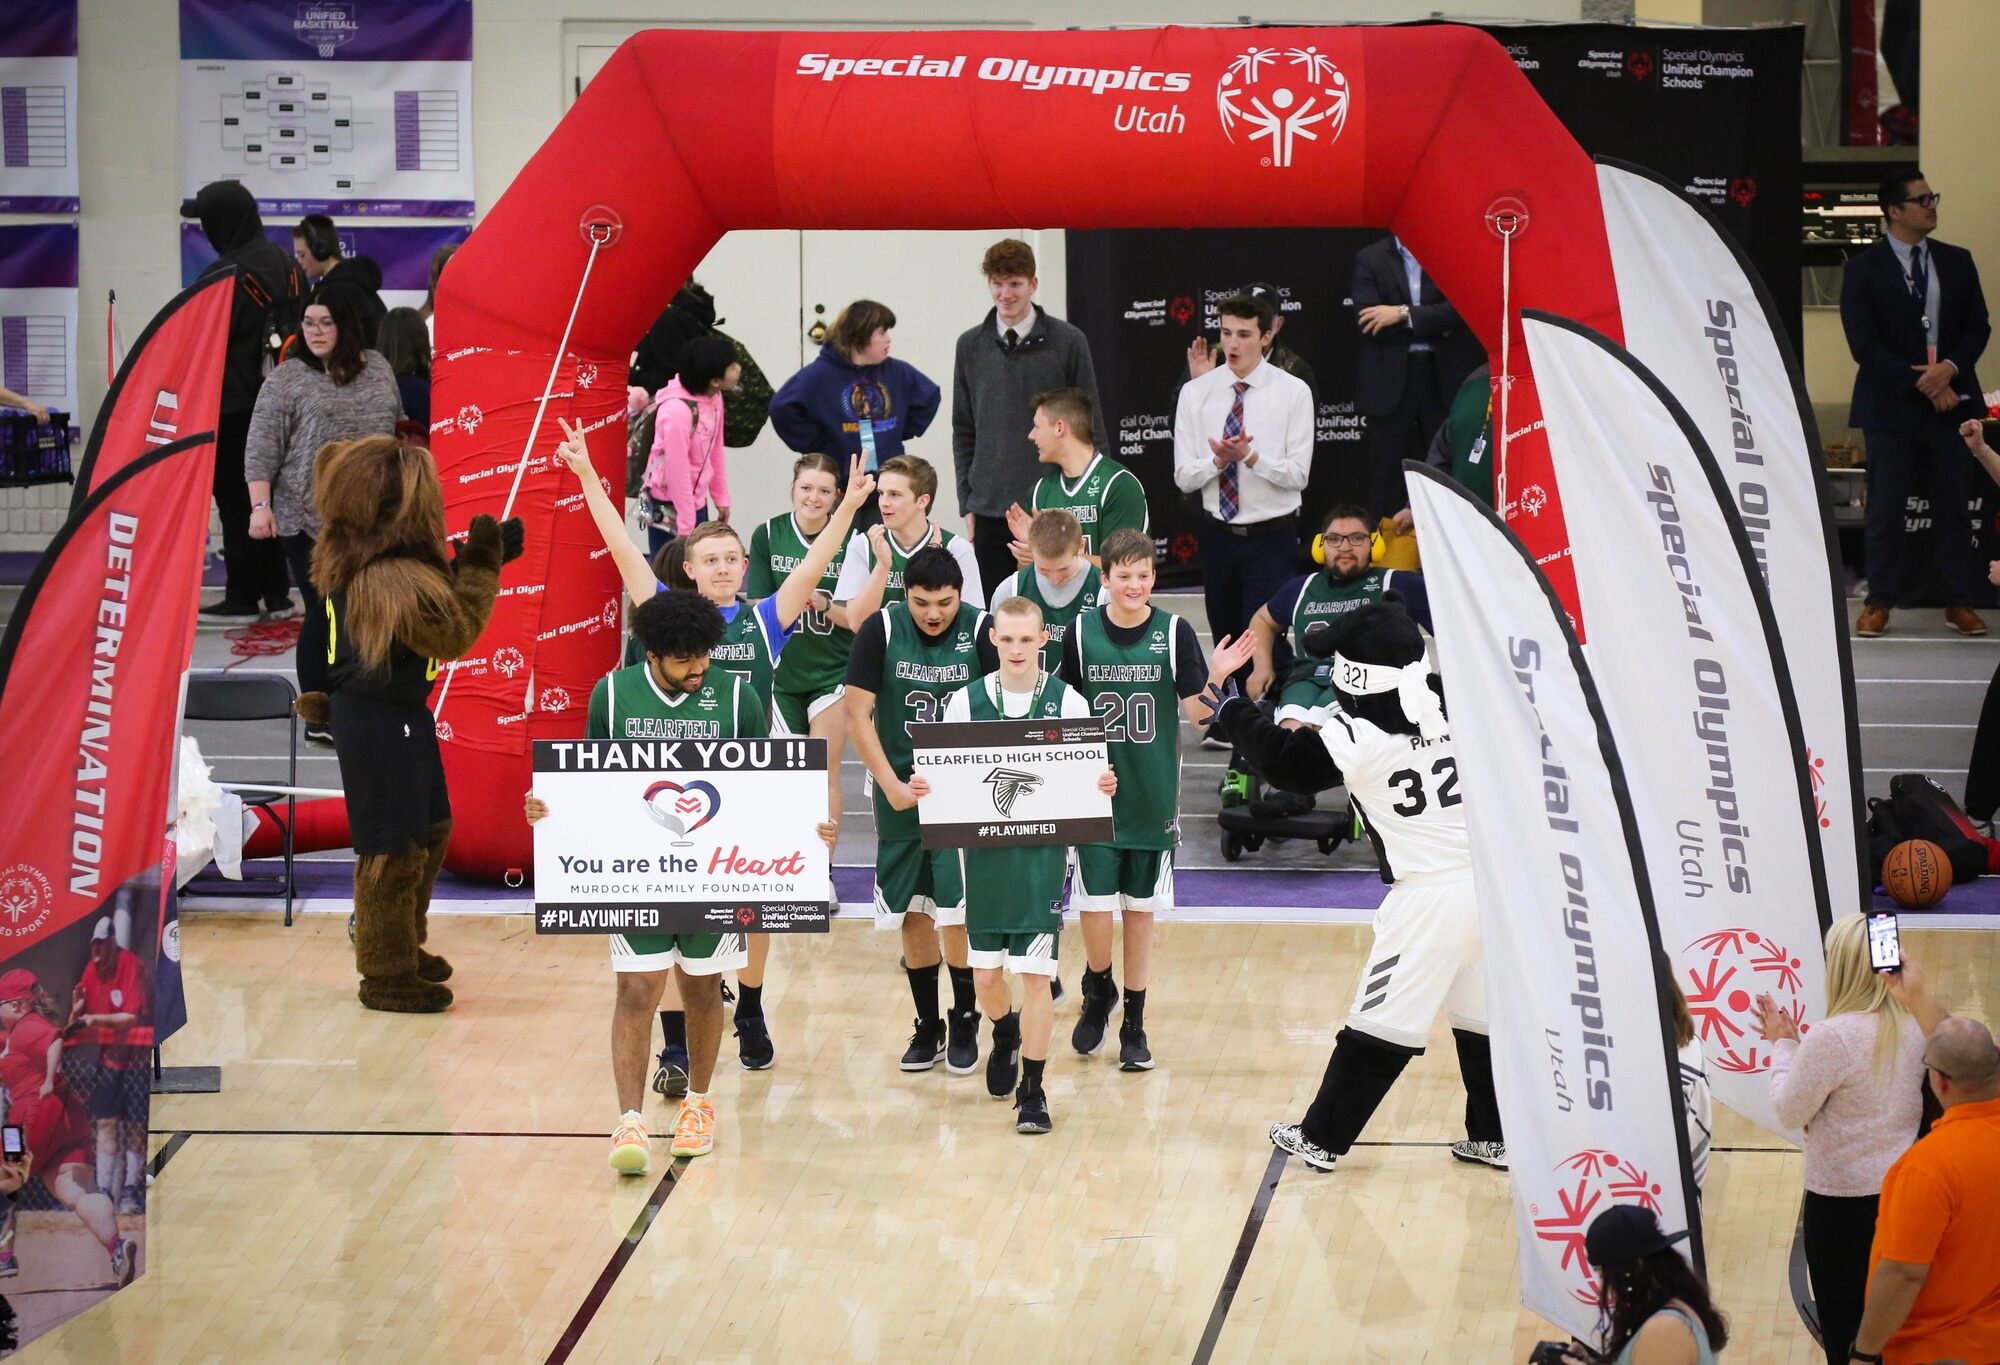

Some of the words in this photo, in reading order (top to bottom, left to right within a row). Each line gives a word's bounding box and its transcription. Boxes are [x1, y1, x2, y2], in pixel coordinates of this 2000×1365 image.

[306, 12, 346, 20] UNIFIED
[294, 20, 358, 29] BASKETBALL
[1588, 50, 1623, 60] Special
[1663, 49, 1697, 62] Special
[1700, 50, 1744, 63] Olympics
[1578, 59, 1623, 69] Olympics
[1663, 63, 1700, 76] Unified
[1703, 65, 1754, 79] Champion
[797, 53, 967, 79] Special
[977, 56, 1191, 94] Olympics
[1663, 77, 1703, 88] Schools
[1114, 104, 1185, 134] Utah
[1694, 177, 1727, 187] Special
[1685, 186, 1727, 196] Olympics
[1205, 289, 1240, 301] Special
[1133, 300, 1166, 310] Special
[1124, 310, 1166, 319] Olympics
[447, 347, 475, 361] Special
[1703, 299, 1764, 466] Special
[1317, 416, 1358, 428] Unified
[1317, 428, 1361, 440] Schools
[459, 468, 494, 484] Special
[530, 465, 548, 475] Utah
[568, 502, 585, 512] Utah
[559, 615, 600, 634] Olympics
[588, 624, 601, 635] Utah
[471, 666, 488, 675] Utah
[896, 661, 969, 681] CLEARFIELD
[1088, 664, 1161, 682] CLEARFIELD
[1343, 663, 1368, 690] 321
[1646, 462, 1714, 643] Special
[1693, 658, 1752, 895] Olympics
[69, 511, 139, 898] DETERMINATION
[1093, 691, 1156, 744] 20
[625, 717, 720, 739] CLEARFIELD
[552, 742, 682, 769] THANK
[694, 742, 772, 768] YOU
[785, 741, 807, 767] !!
[916, 753, 1002, 767] CLEARFIELD
[1006, 752, 1042, 763] HIGH
[1045, 749, 1105, 762] SCHOOL
[1388, 756, 1462, 818] 32
[977, 823, 1057, 838] #PLAYUNIFIED
[558, 854, 603, 875] You
[612, 857, 650, 873] are
[659, 854, 698, 873] the
[707, 845, 806, 877] Heart
[1676, 819, 1713, 899] Utah
[1916, 847, 1931, 895] SPALDING
[17, 863, 53, 900] OLYMPICS
[570, 883, 639, 893] MURDOCK
[646, 883, 695, 893] FAMILY
[702, 882, 795, 893] FOUNDATION
[761, 904, 786, 913] Special
[786, 904, 819, 915] Olympics
[761, 913, 788, 921] Unified
[789, 912, 826, 922] Champion
[15, 908, 50, 937] SPORTS
[540, 909, 660, 929] #PLAYUNIFIED
[761, 921, 791, 929] Schools
[1559, 852, 1614, 1112] Olympics
[1545, 1027, 1575, 1113] Utah
